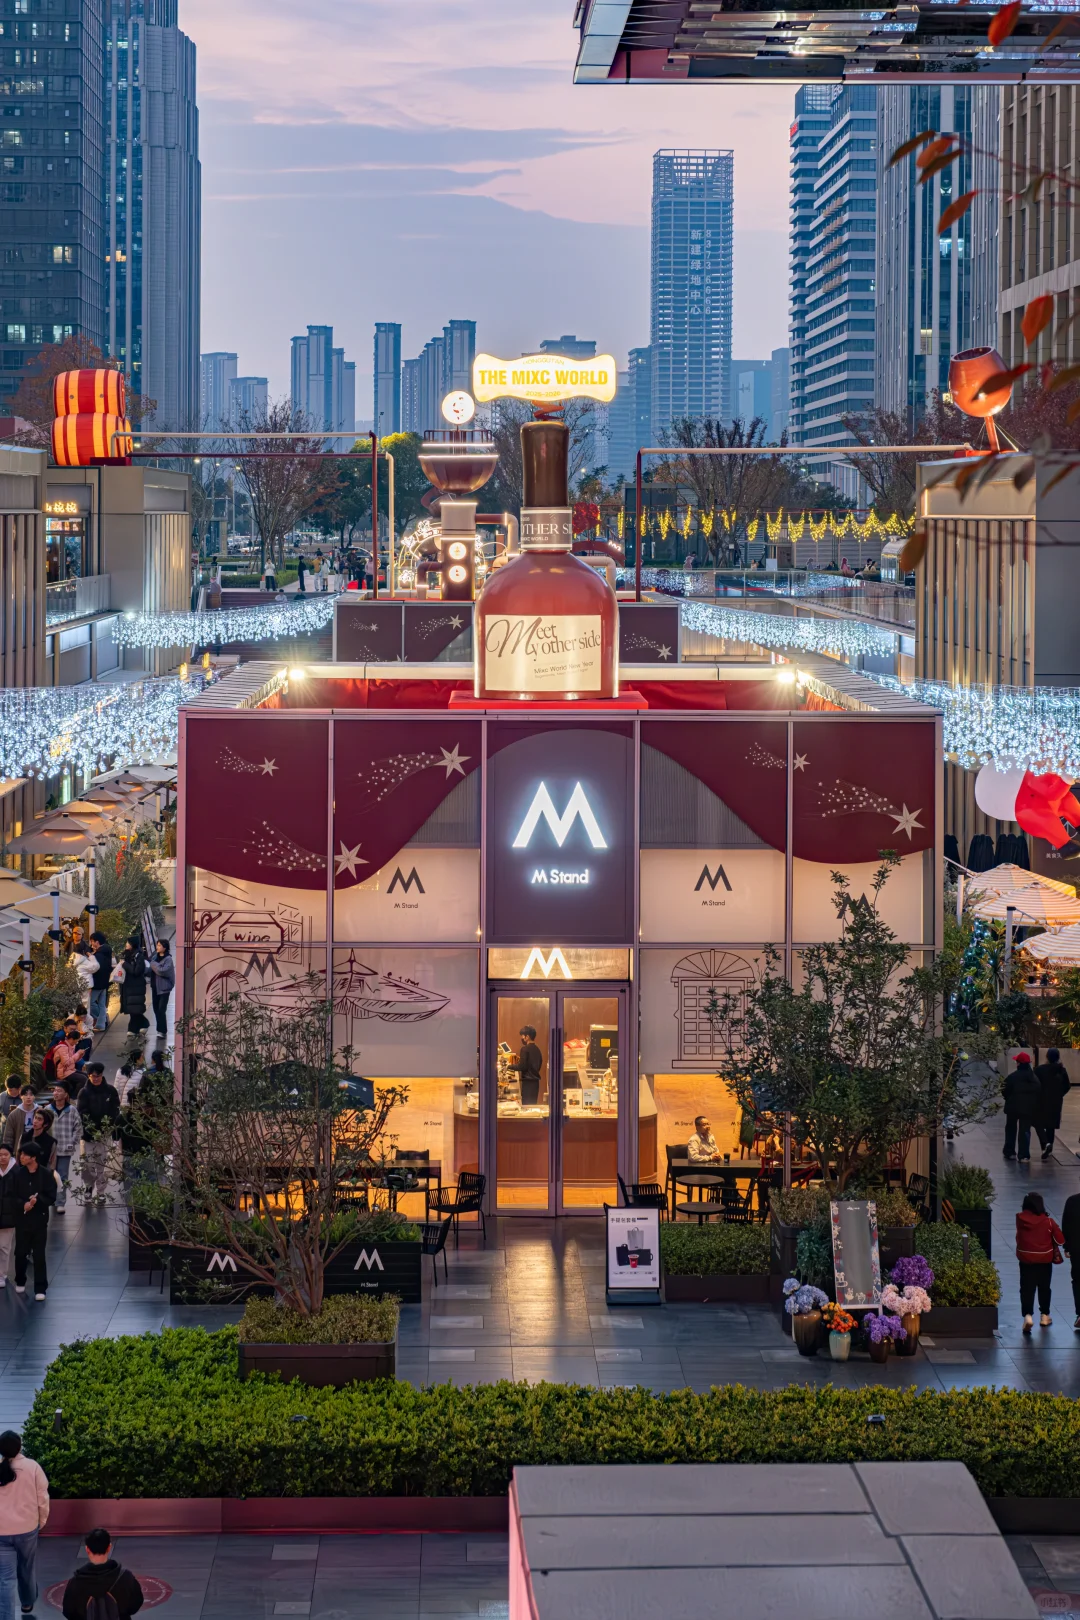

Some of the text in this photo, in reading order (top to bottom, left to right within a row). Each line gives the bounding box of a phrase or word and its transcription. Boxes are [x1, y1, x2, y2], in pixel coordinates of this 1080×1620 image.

[690, 229, 702, 315] 新建绿地中心
[479, 370, 608, 385] THE MIXC WORLD
[541, 634, 577, 655] other
[578, 629, 601, 650] side
[550, 869, 589, 884] Stand
[234, 931, 271, 942] wine
